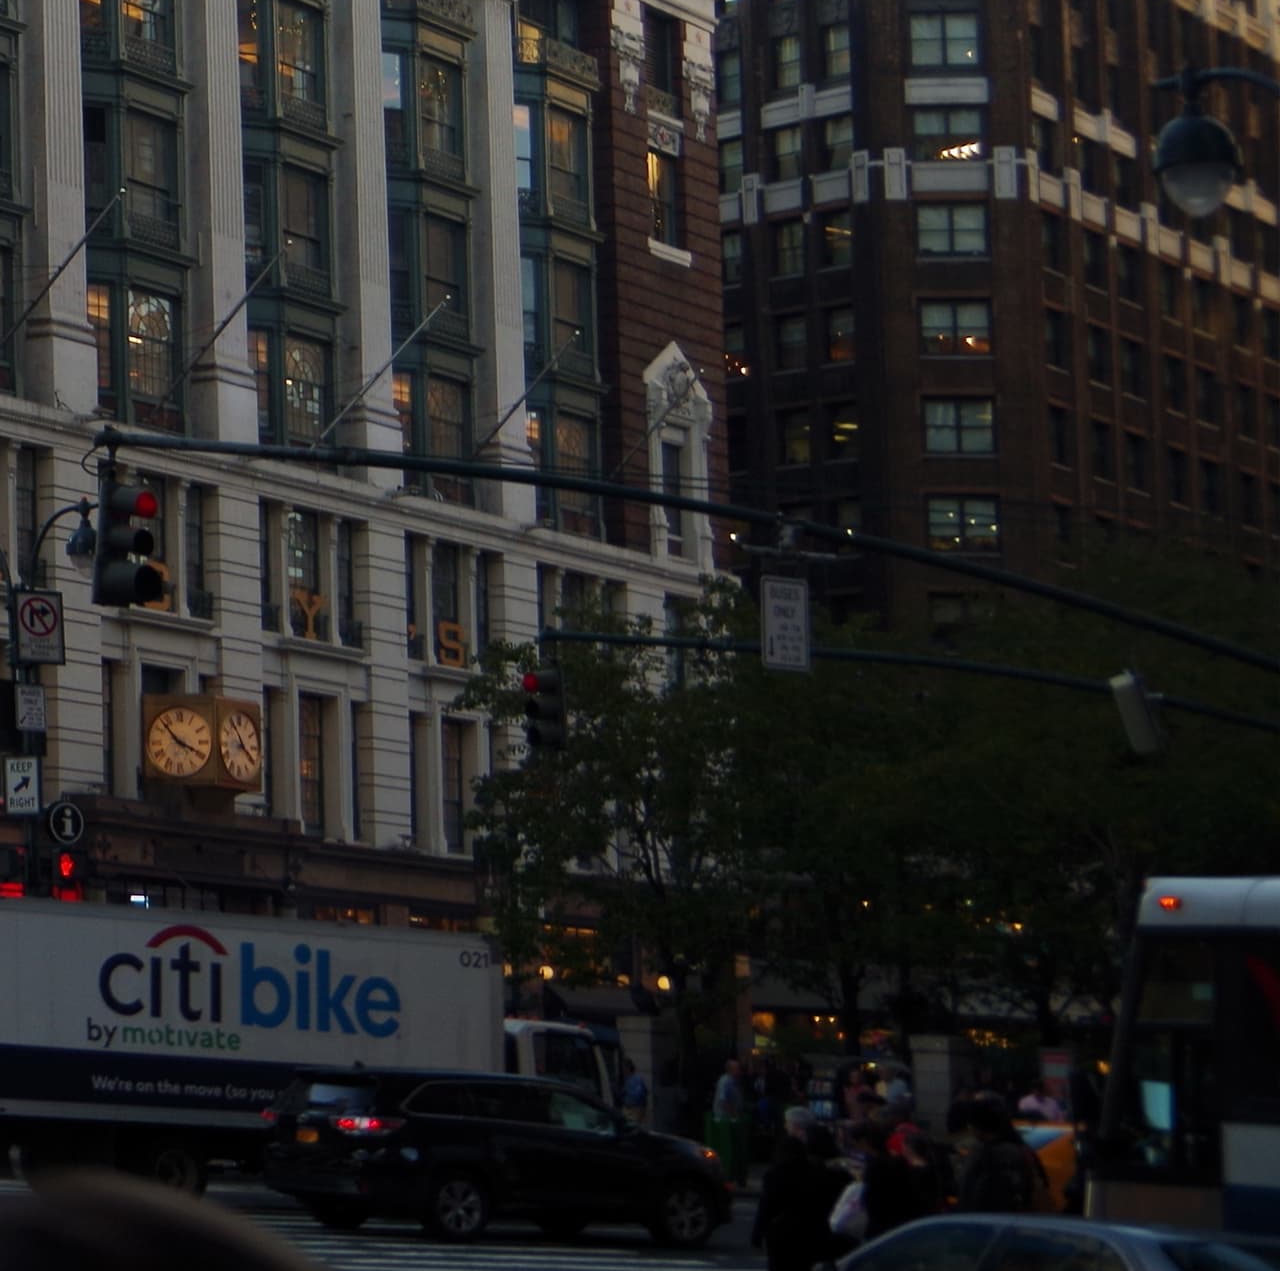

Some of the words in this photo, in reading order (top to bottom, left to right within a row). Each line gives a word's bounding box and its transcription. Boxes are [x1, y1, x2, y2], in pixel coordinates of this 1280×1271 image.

[9, 761, 33, 774] KEEP
[9, 796, 36, 809] RIGHT
[459, 950, 489, 969] 021
[99, 941, 223, 1023] citi
[240, 941, 401, 1039] bike
[87, 1017, 118, 1048] by
[121, 1025, 241, 1051] motivate
[91, 1074, 133, 1093] We're
[138, 1080, 154, 1093] on
[157, 1078, 180, 1095] the
[184, 1084, 222, 1098] move
[250, 1087, 275, 1105] you
